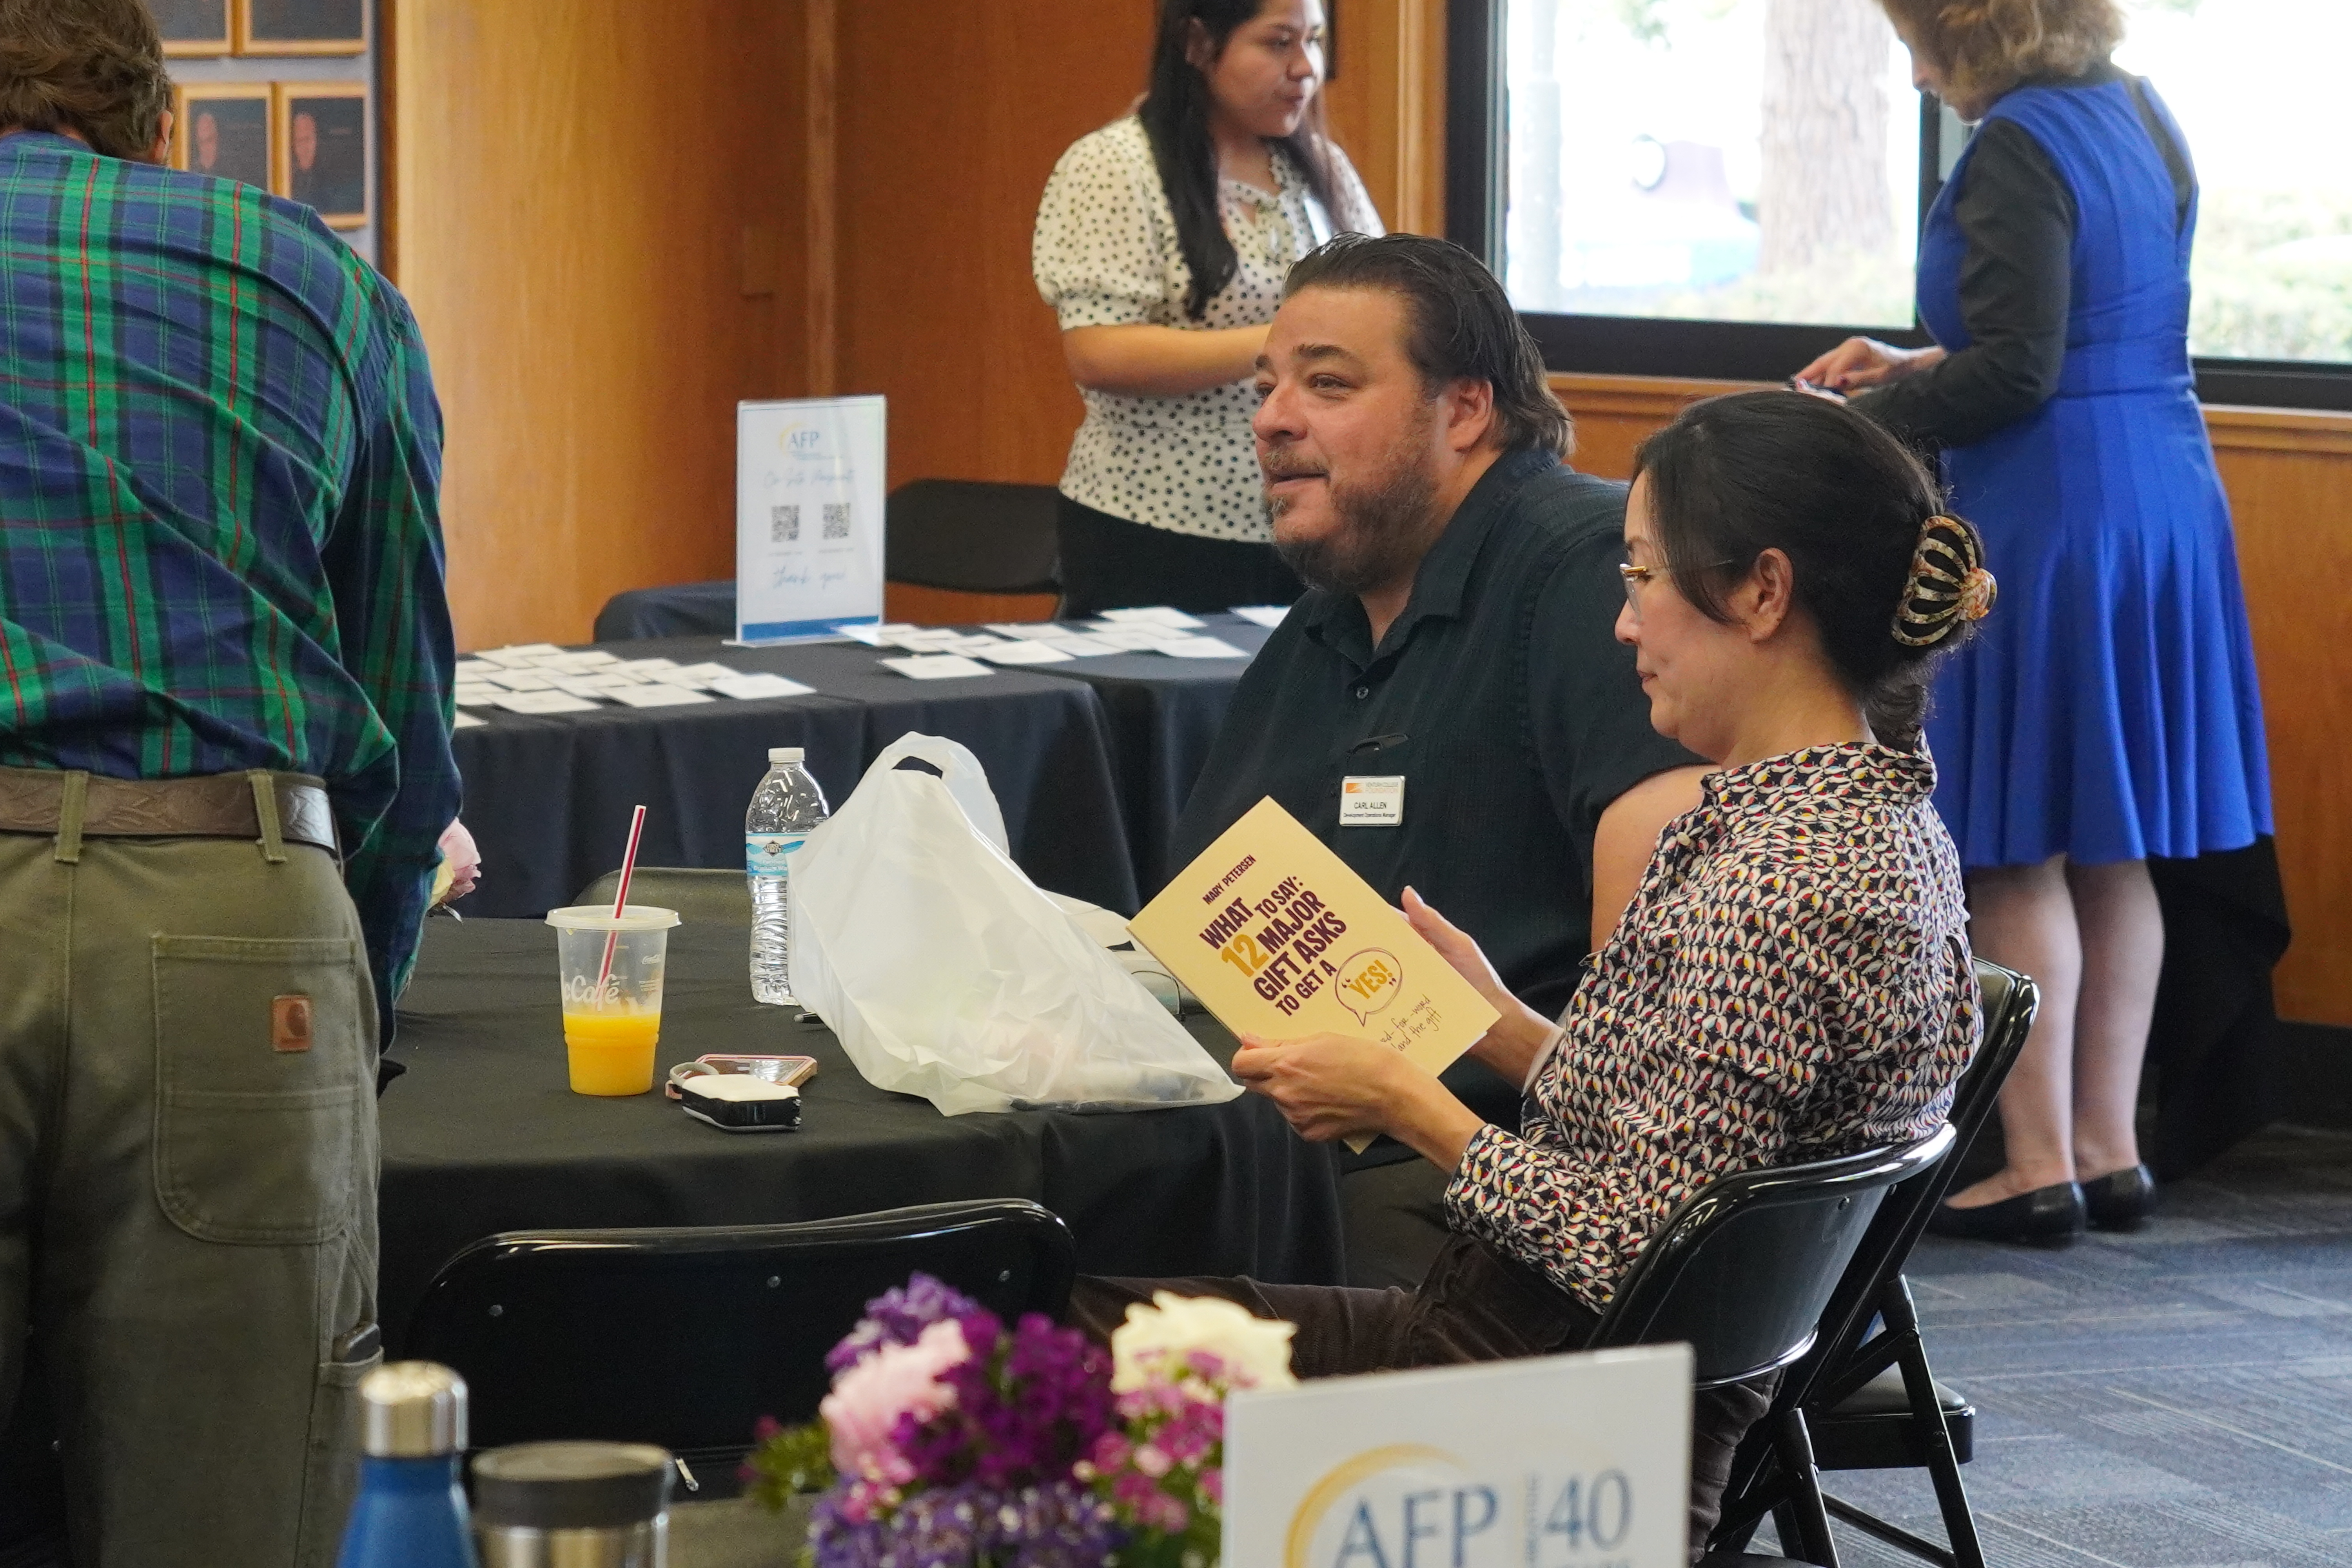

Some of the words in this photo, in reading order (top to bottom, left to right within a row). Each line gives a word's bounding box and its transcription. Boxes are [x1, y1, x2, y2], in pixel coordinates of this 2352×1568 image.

[788, 432, 820, 448] AFP
[1202, 882, 1225, 905] MARY
[1221, 854, 1256, 887] PETERSEN
[1199, 897, 1254, 950] WHAT
[1254, 898, 1278, 919] TO
[1270, 876, 1303, 906] SAY:
[1221, 934, 1269, 978] 12
[1256, 890, 1327, 955] MAJOR
[1254, 951, 1302, 1001] GIFT
[1292, 911, 1347, 965] ASKS
[1275, 994, 1300, 1016] TO
[1295, 969, 1324, 999] GET
[1319, 959, 1337, 977] A
[1409, 1023, 1426, 1038] the
[1425, 1007, 1442, 1032] gift
[1332, 1482, 1501, 1568] AFP
[1544, 1469, 1632, 1551] 40
